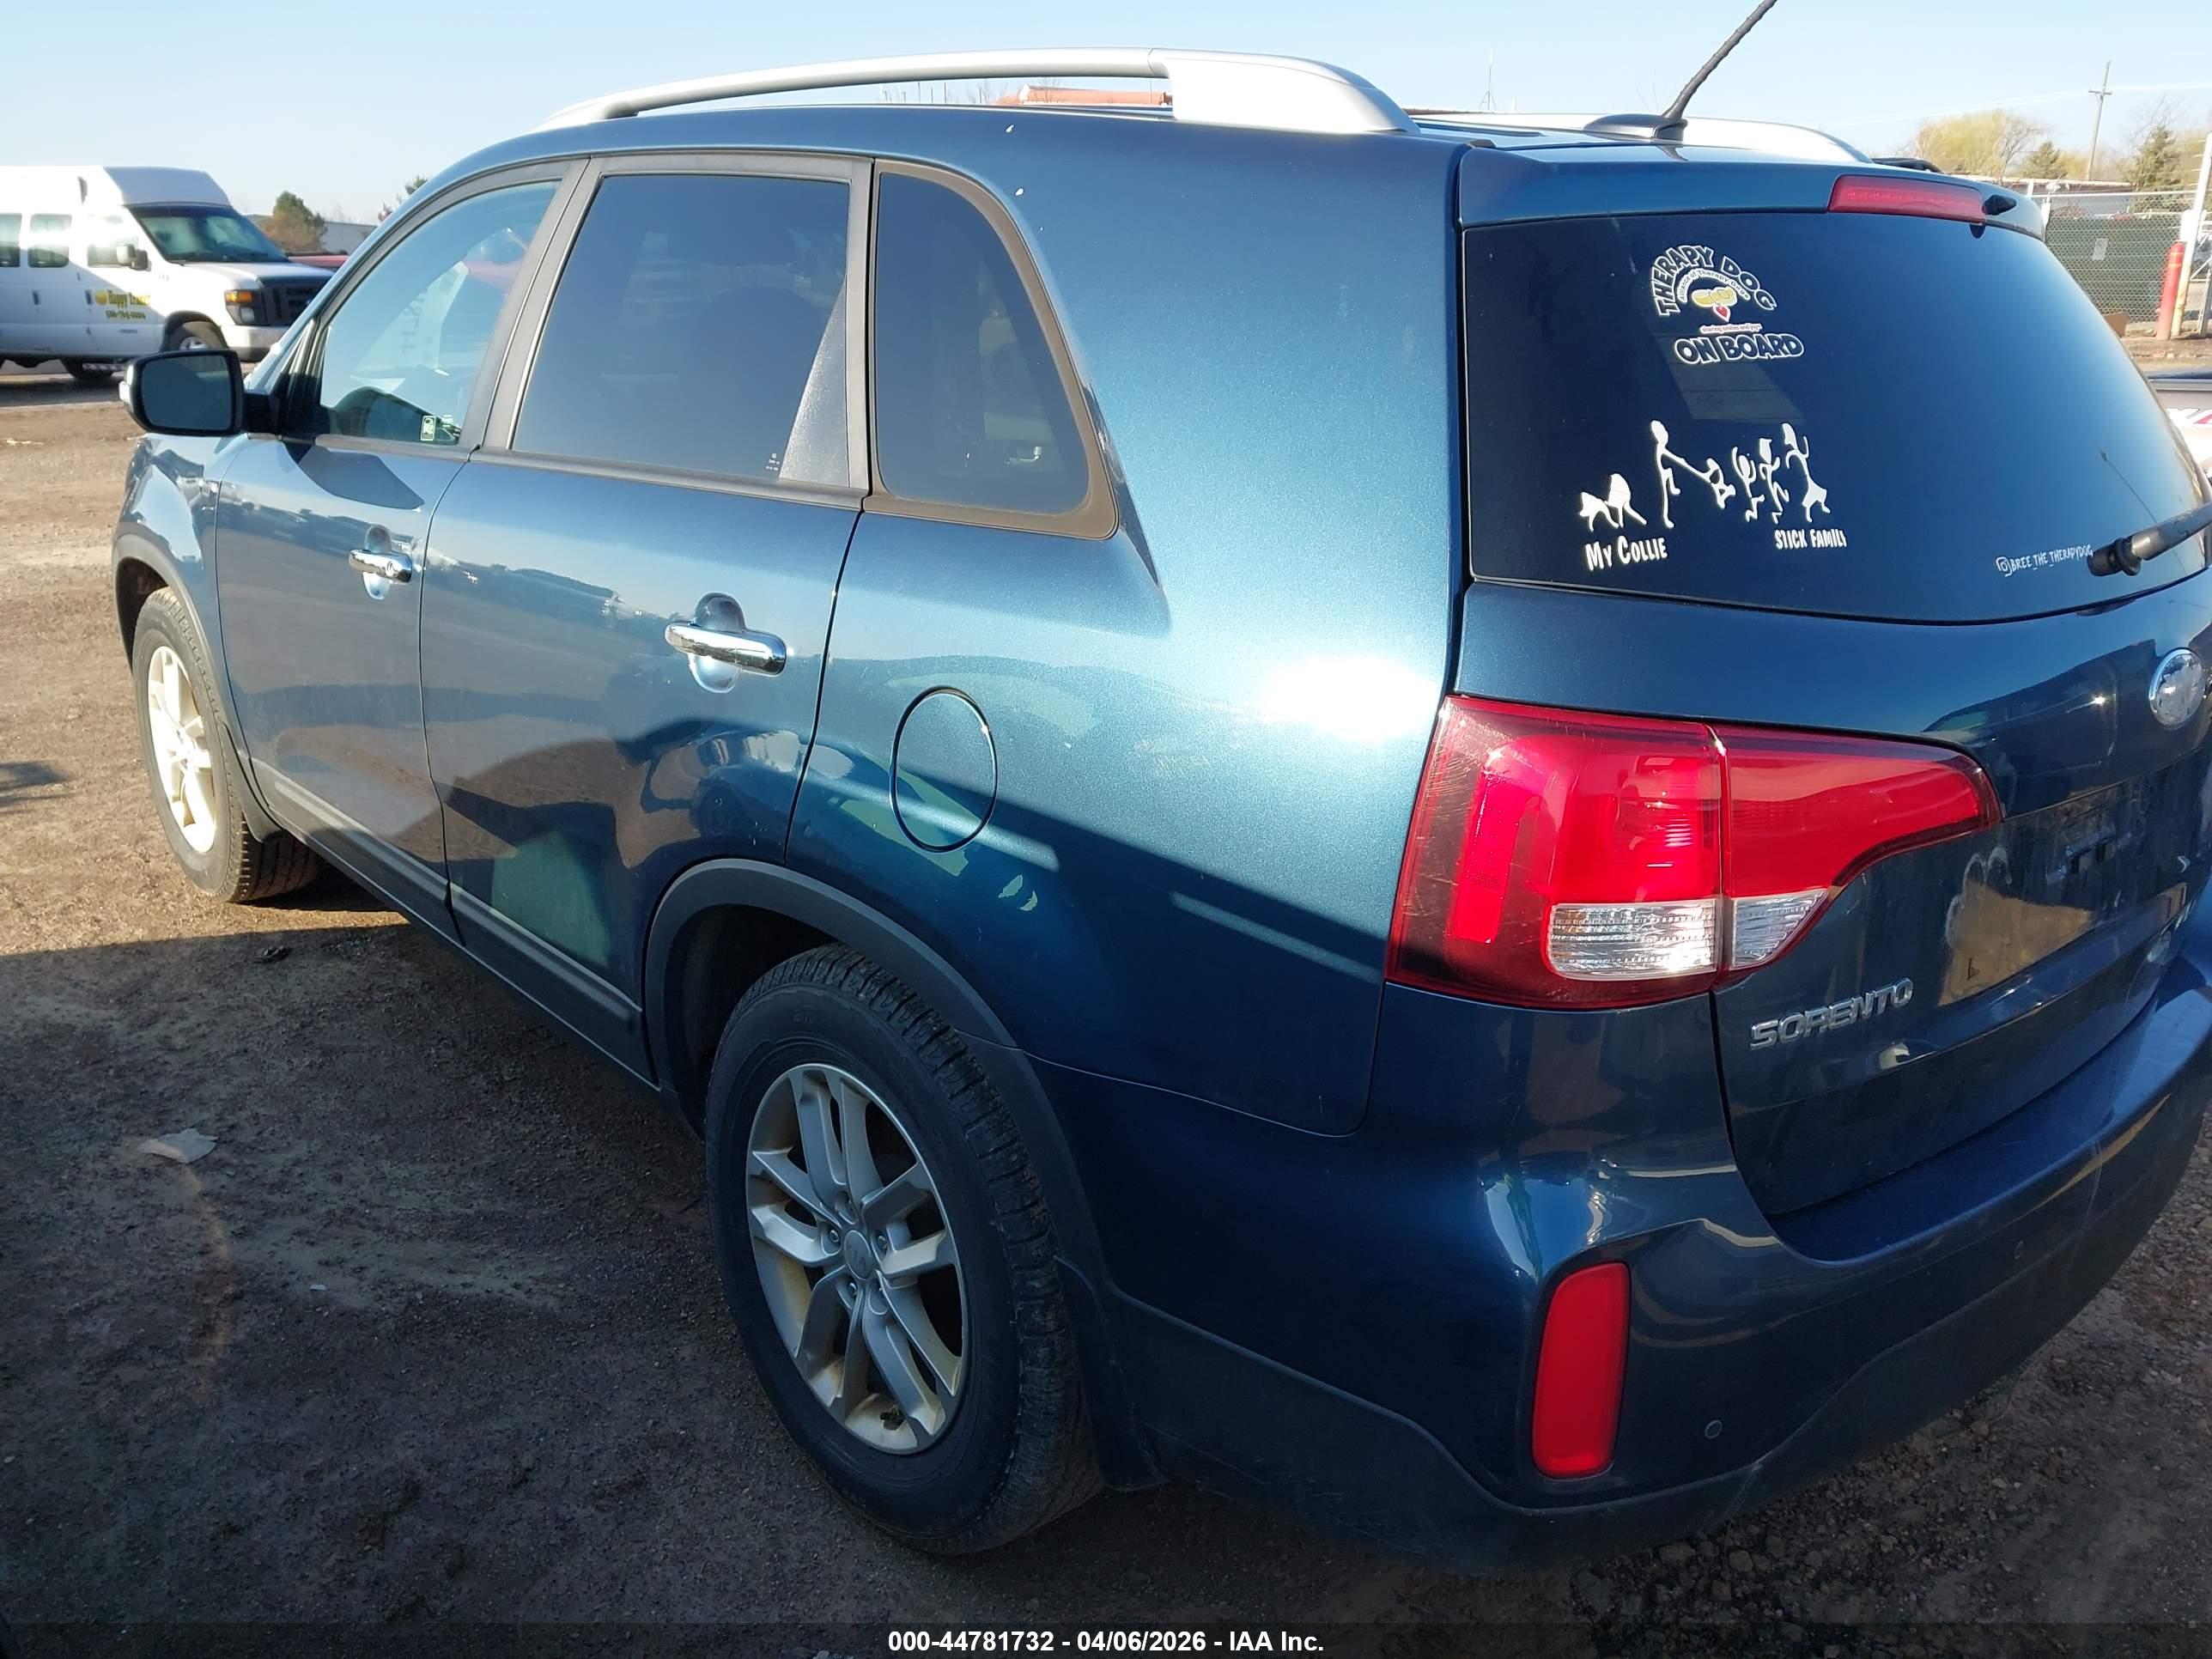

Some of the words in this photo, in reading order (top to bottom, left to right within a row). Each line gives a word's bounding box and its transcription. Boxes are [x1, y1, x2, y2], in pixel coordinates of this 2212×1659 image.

[1650, 245, 1714, 316] THERAPY
[1721, 256, 1778, 310] DOG
[1674, 337, 1720, 364] ON
[1717, 333, 1804, 360] BOARD
[1750, 977, 1914, 1051] SORENTO
